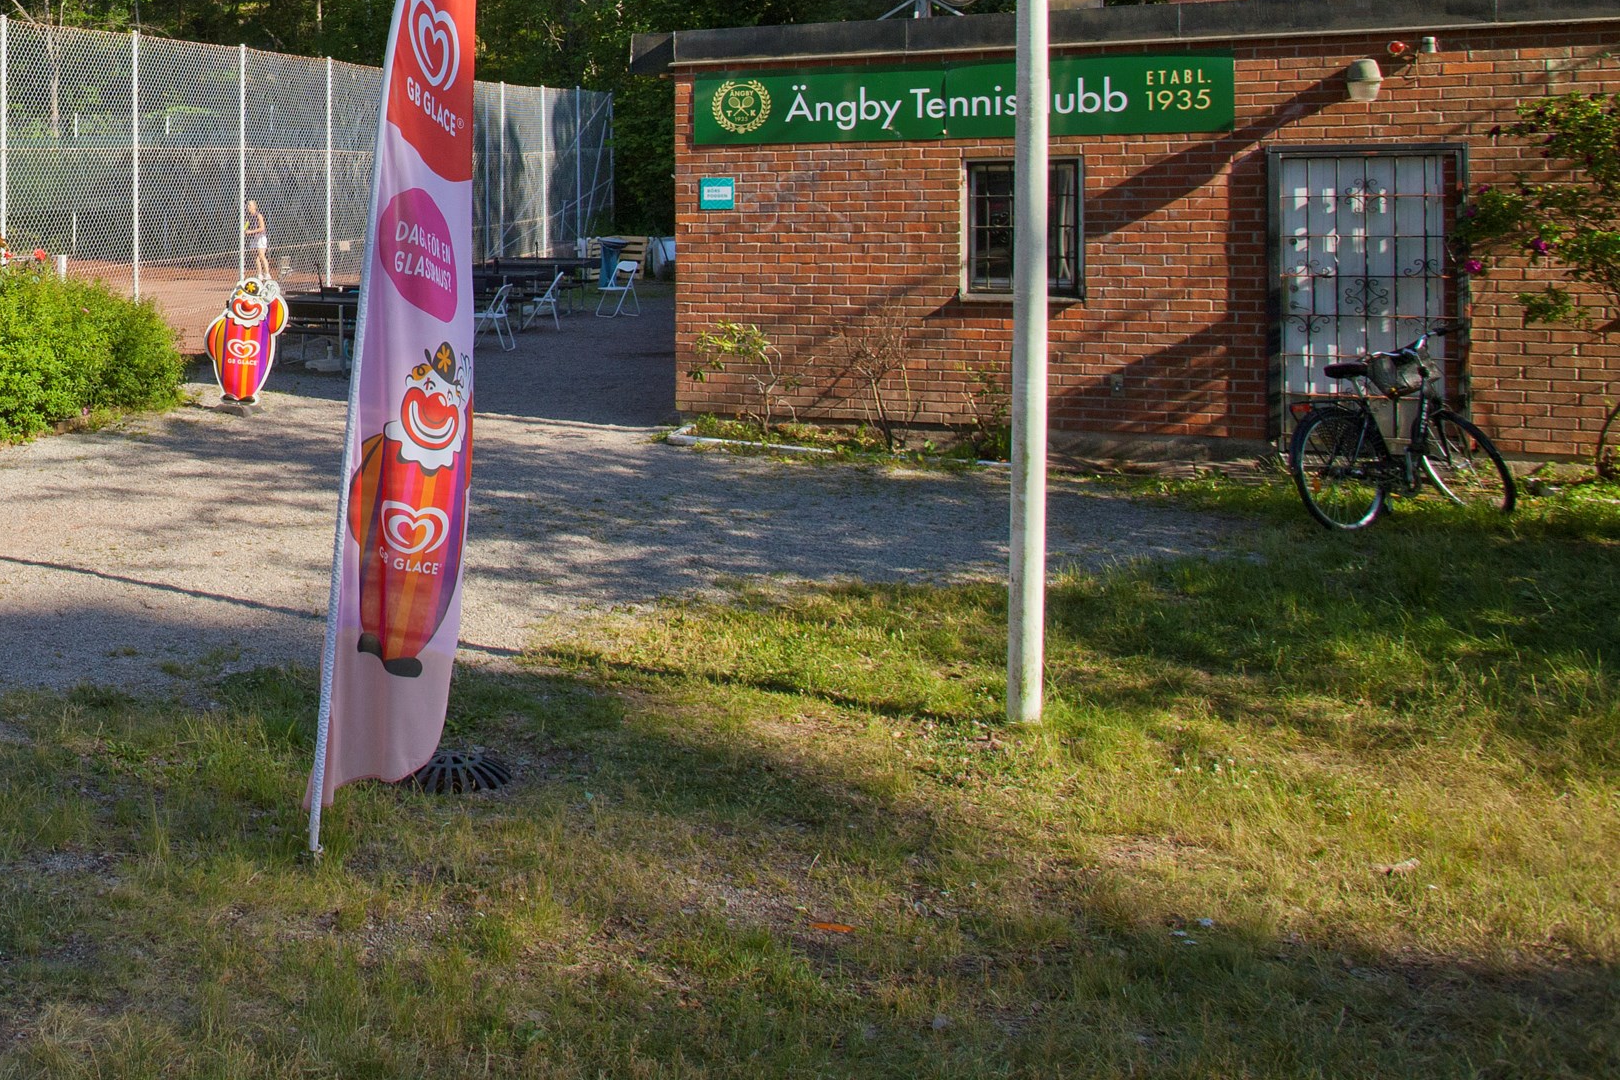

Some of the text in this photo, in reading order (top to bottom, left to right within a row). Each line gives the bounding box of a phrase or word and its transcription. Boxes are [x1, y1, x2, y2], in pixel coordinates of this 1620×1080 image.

[1146, 69, 1212, 86] ETABL.
[407, 76, 421, 107] GB
[729, 89, 754, 97] ÄNGBY
[1145, 89, 1212, 111] 1935
[785, 84, 902, 130] Ängby
[393, 557, 440, 575] GLACE
